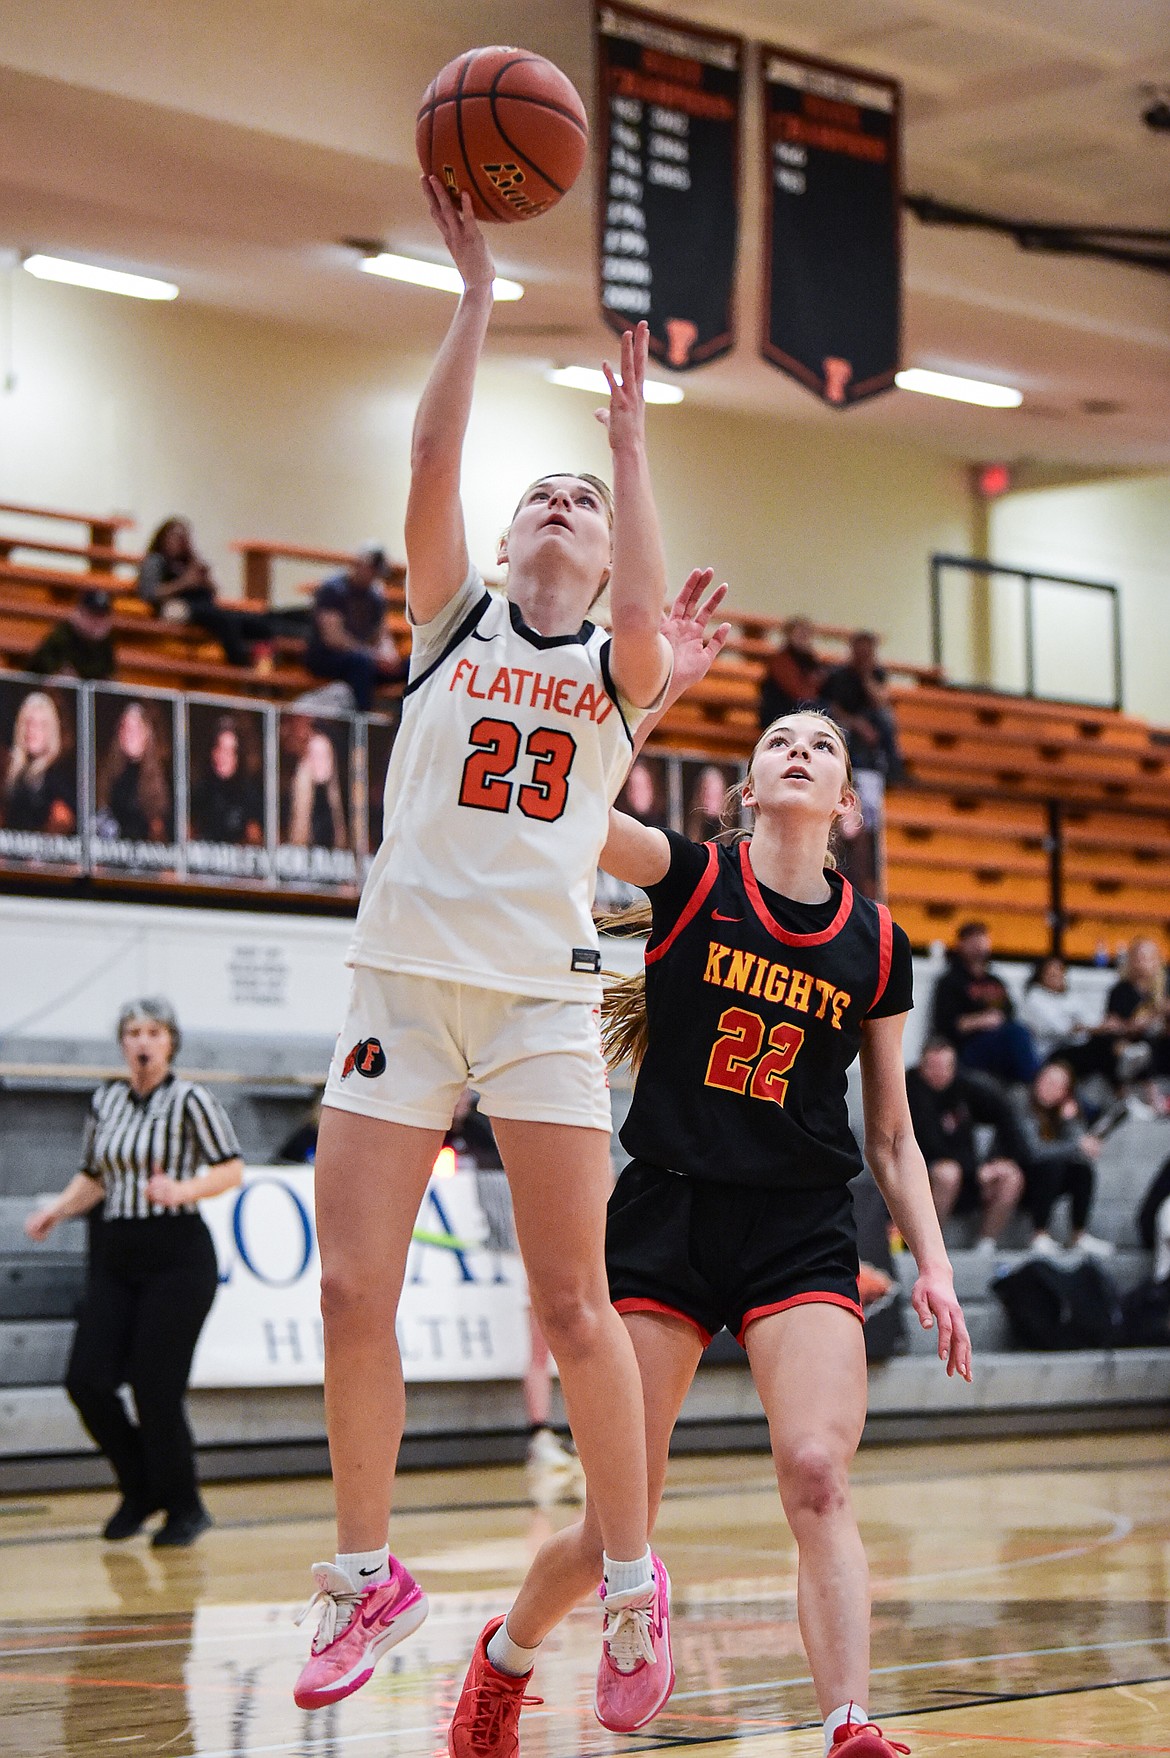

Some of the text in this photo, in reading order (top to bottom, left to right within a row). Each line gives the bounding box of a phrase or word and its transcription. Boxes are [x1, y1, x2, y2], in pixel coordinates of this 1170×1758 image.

[449, 658, 614, 725] FLATHEAD
[458, 717, 577, 823] 23
[703, 941, 852, 1030] KNIGHTS
[361, 1043, 380, 1072] F
[704, 1006, 805, 1109] 22
[262, 1316, 496, 1364] HLTH
